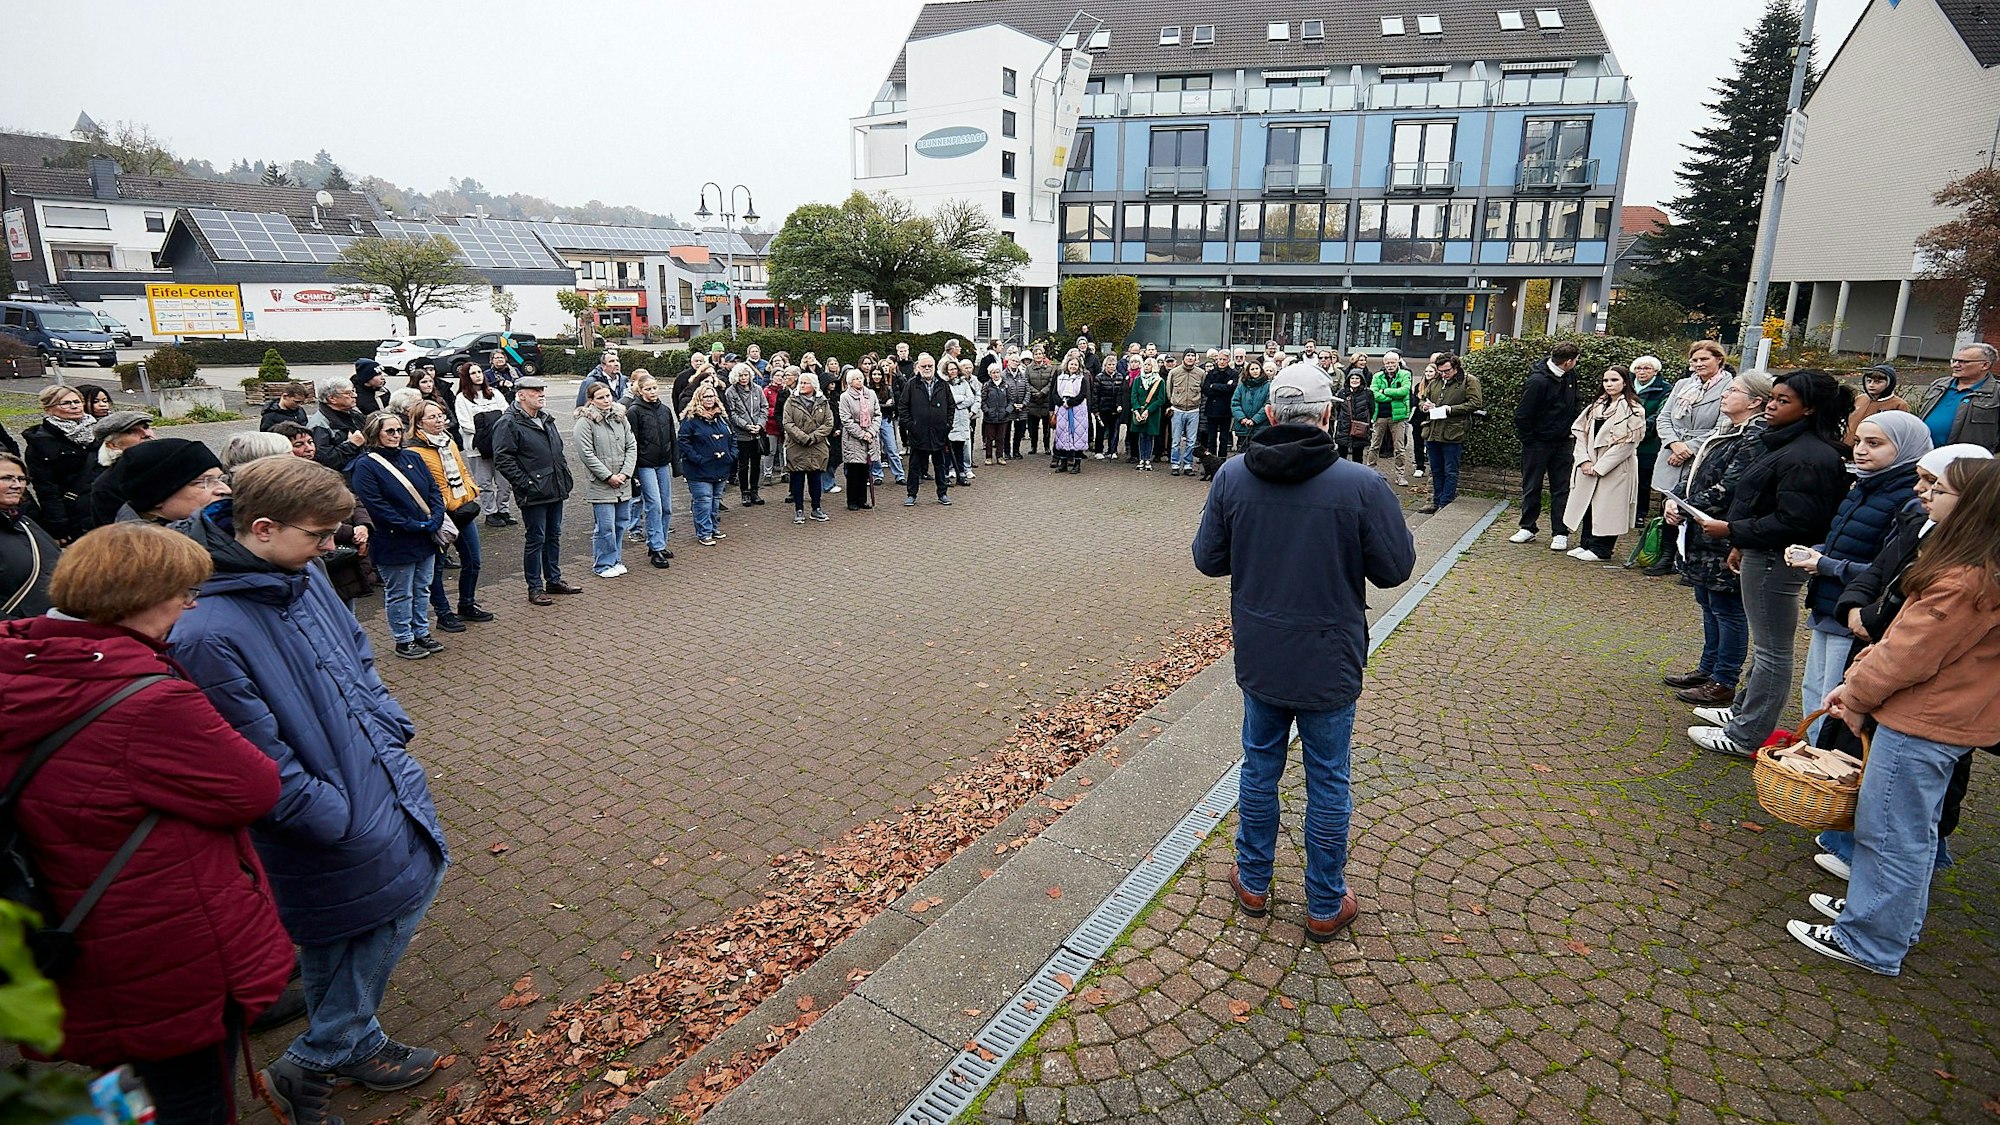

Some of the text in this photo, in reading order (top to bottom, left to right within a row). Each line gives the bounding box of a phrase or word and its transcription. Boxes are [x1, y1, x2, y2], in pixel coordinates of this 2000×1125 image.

[917, 132, 986, 149] BRUNNENPASSAGE
[152, 288, 234, 297] Eifel-Center
[296, 292, 334, 300] SCHMITZ
